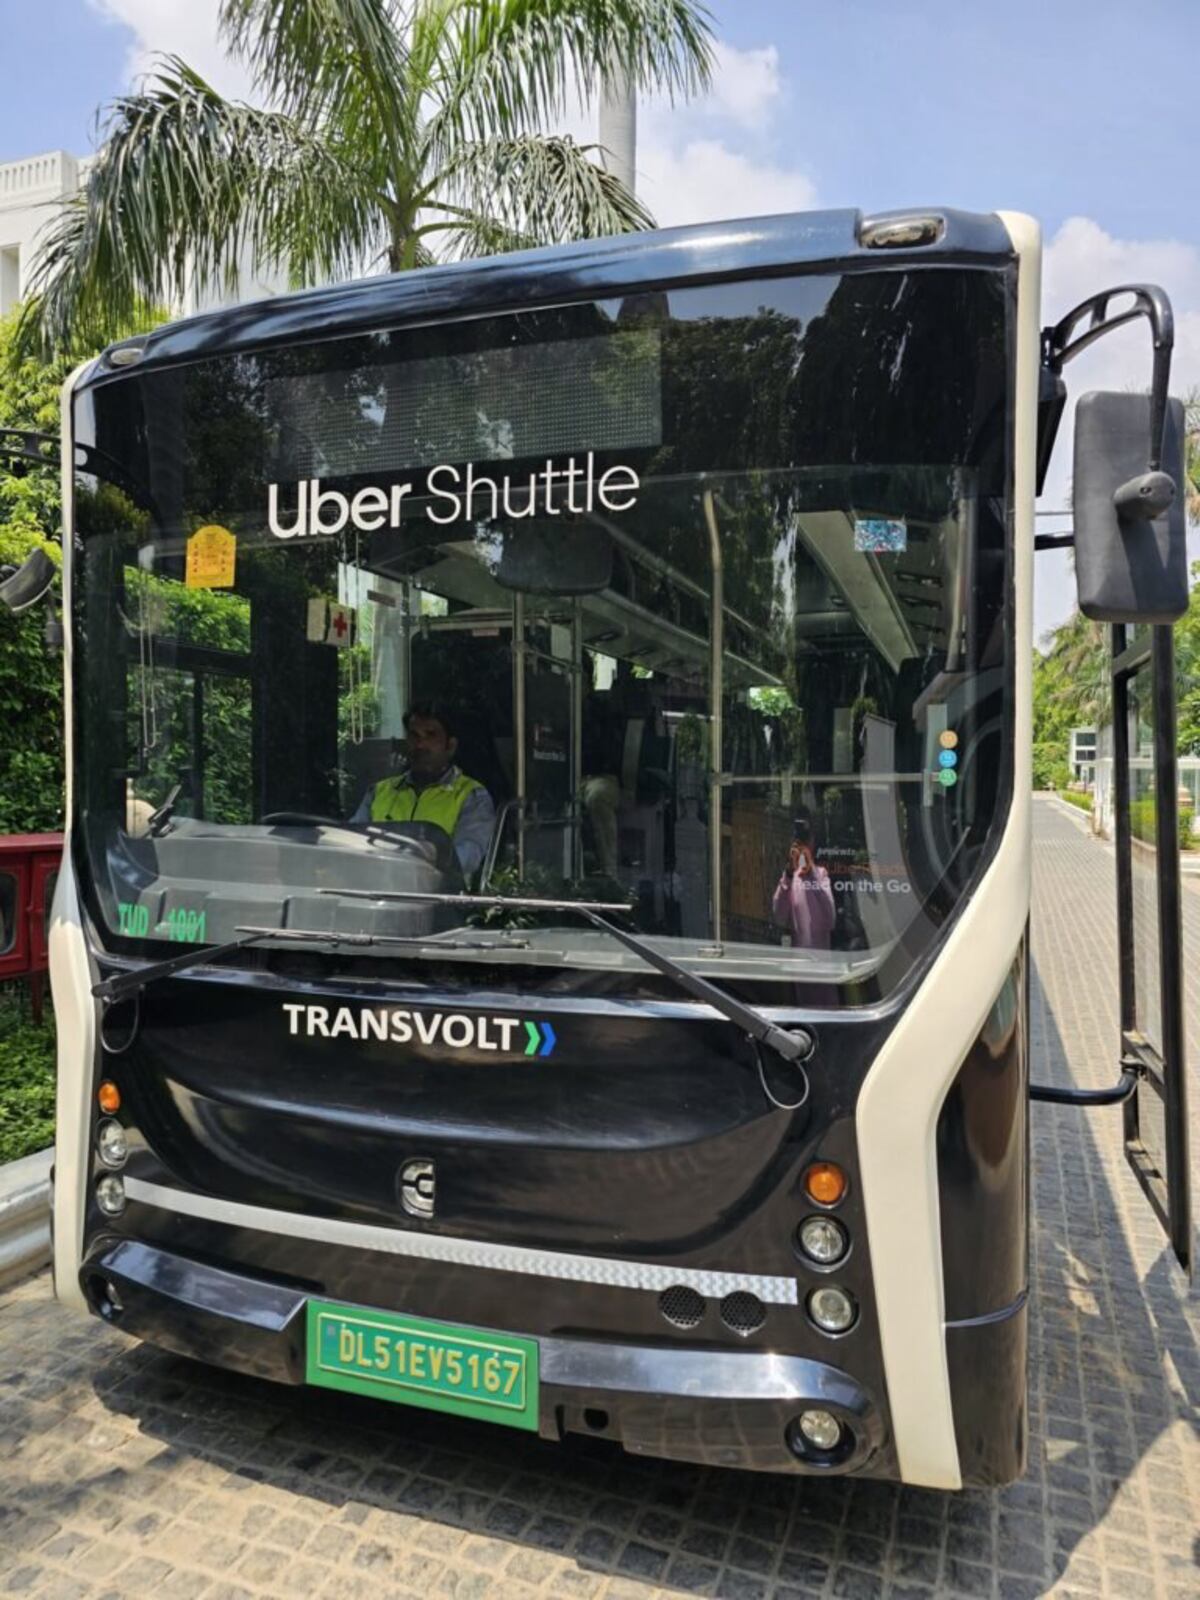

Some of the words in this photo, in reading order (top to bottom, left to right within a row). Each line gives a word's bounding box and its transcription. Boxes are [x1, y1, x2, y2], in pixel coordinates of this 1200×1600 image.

[268, 479, 412, 539] Uber
[426, 452, 640, 524] Shuttle
[834, 881, 854, 892] on
[857, 879, 883, 893] the
[886, 879, 911, 893] Go
[282, 1003, 520, 1051] TRANSVOLT
[338, 1326, 521, 1396] DL51EV5167
